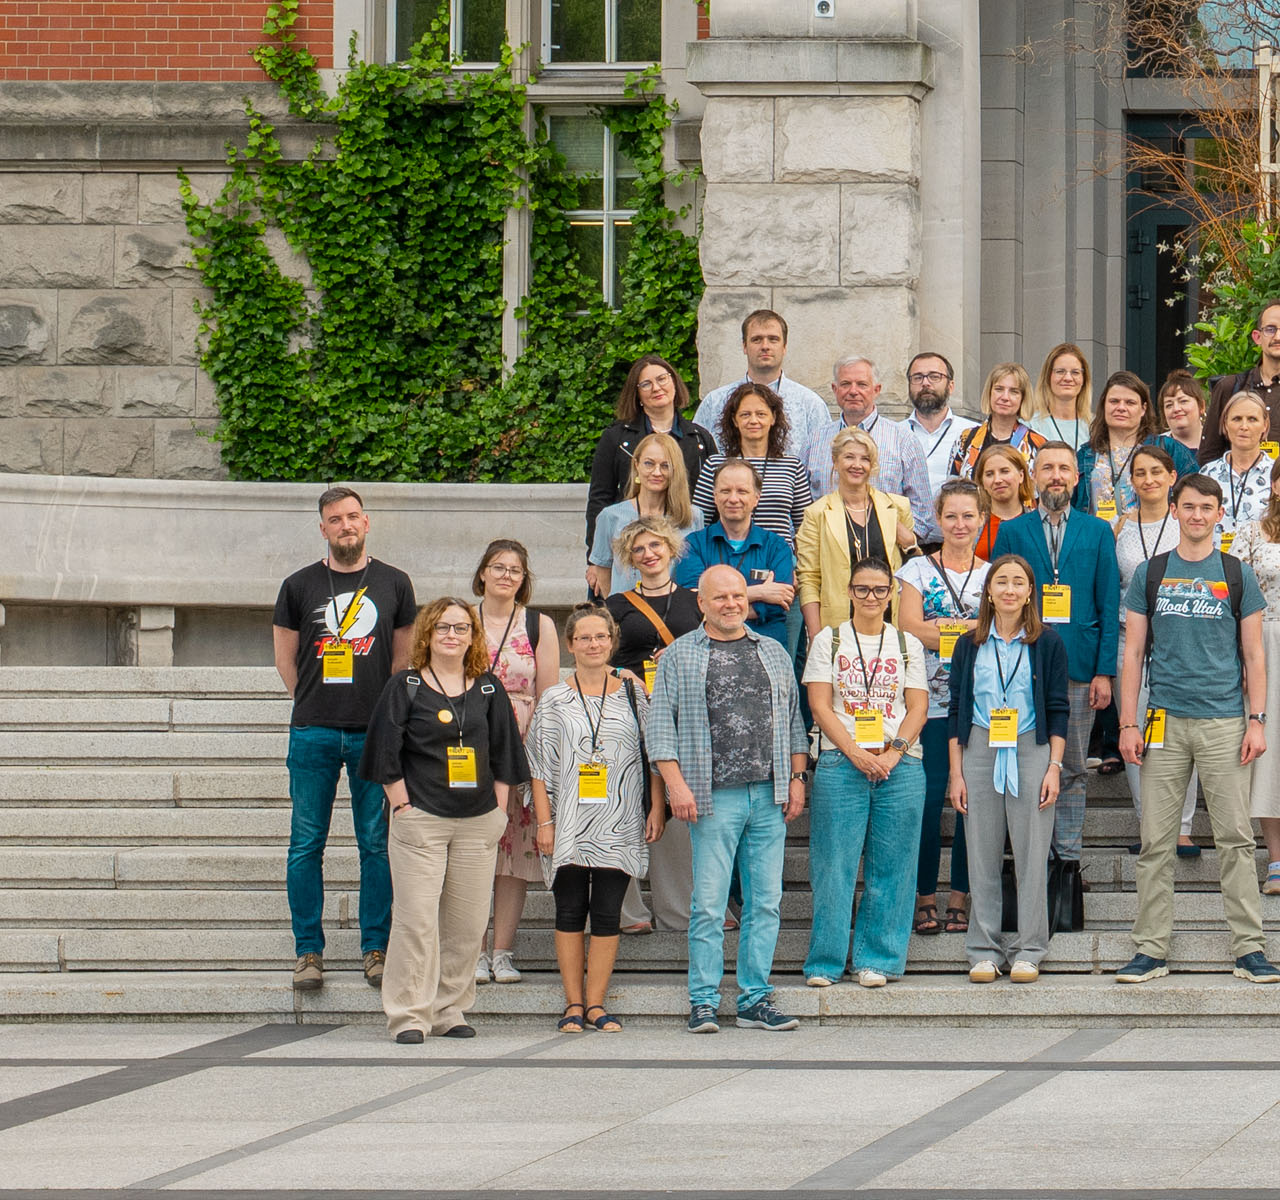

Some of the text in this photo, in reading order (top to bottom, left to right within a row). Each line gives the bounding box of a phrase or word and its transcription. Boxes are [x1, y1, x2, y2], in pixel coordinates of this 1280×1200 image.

[1156, 597, 1223, 616] Moab Utah
[838, 654, 898, 675] DOGS
